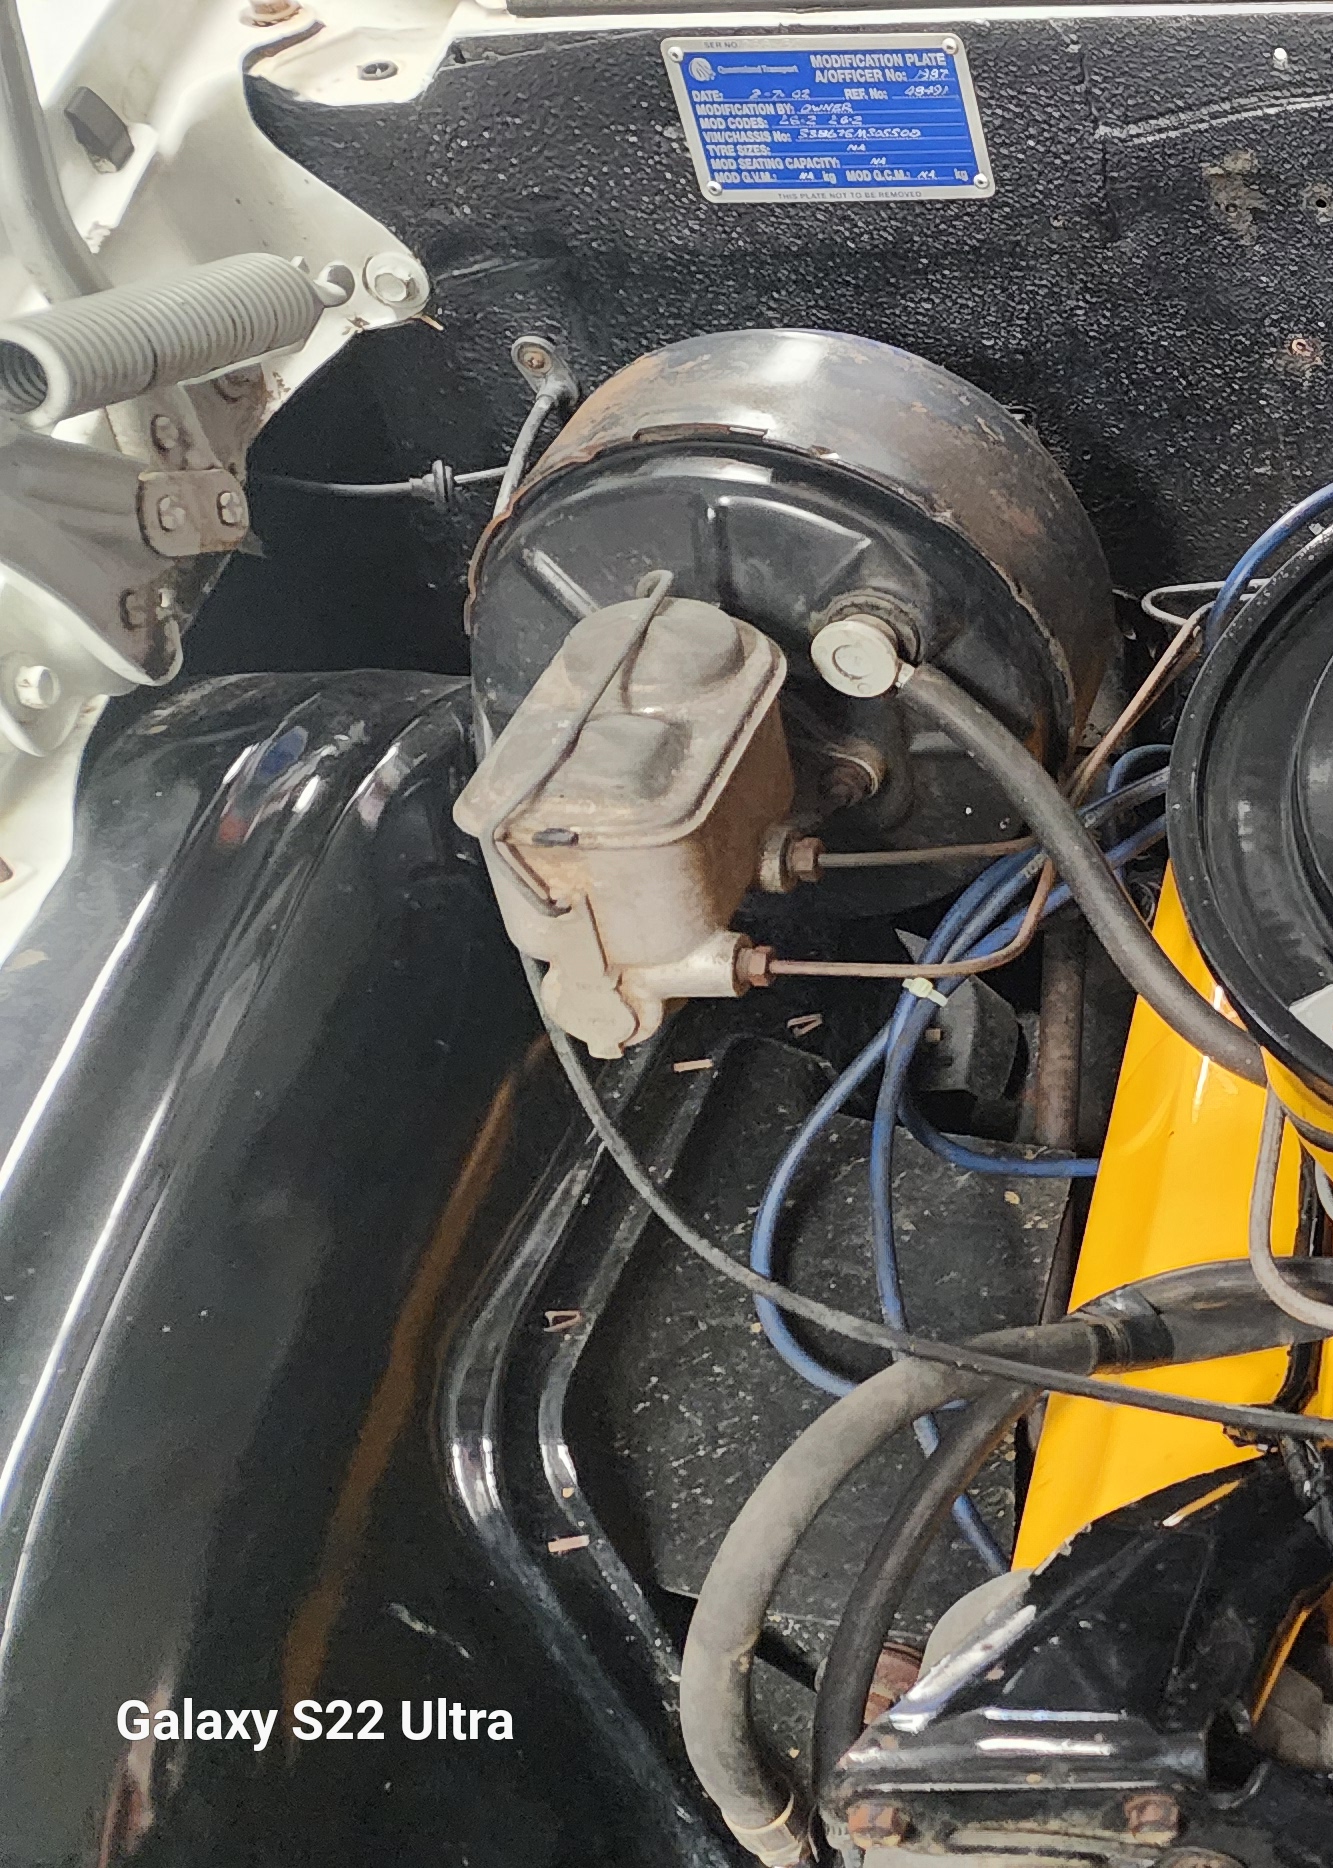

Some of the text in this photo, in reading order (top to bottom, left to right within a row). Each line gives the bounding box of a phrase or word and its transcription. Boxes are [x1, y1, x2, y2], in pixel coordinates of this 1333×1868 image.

[810, 52, 947, 69] MODIFICATION PLATE
[815, 69, 884, 83] A/OFFICER
[691, 89, 724, 102] DATE:
[695, 102, 854, 116] MODIFICATION BY: OWNER
[699, 117, 726, 129] MOD
[727, 116, 769, 129] CODES:
[702, 131, 772, 143] VIN/CHASSIS
[705, 144, 736, 156] TYRE
[736, 144, 772, 156] SIZES:
[711, 158, 737, 170] MOD
[738, 157, 784, 170] SEATING
[784, 156, 841, 169] CAPACITY:
[713, 171, 741, 183] MOD
[822, 170, 837, 184] kg
[845, 169, 872, 182] MOD
[953, 167, 969, 182] kg
[799, 192, 827, 200] PLATE
[878, 191, 922, 199] REMOVED
